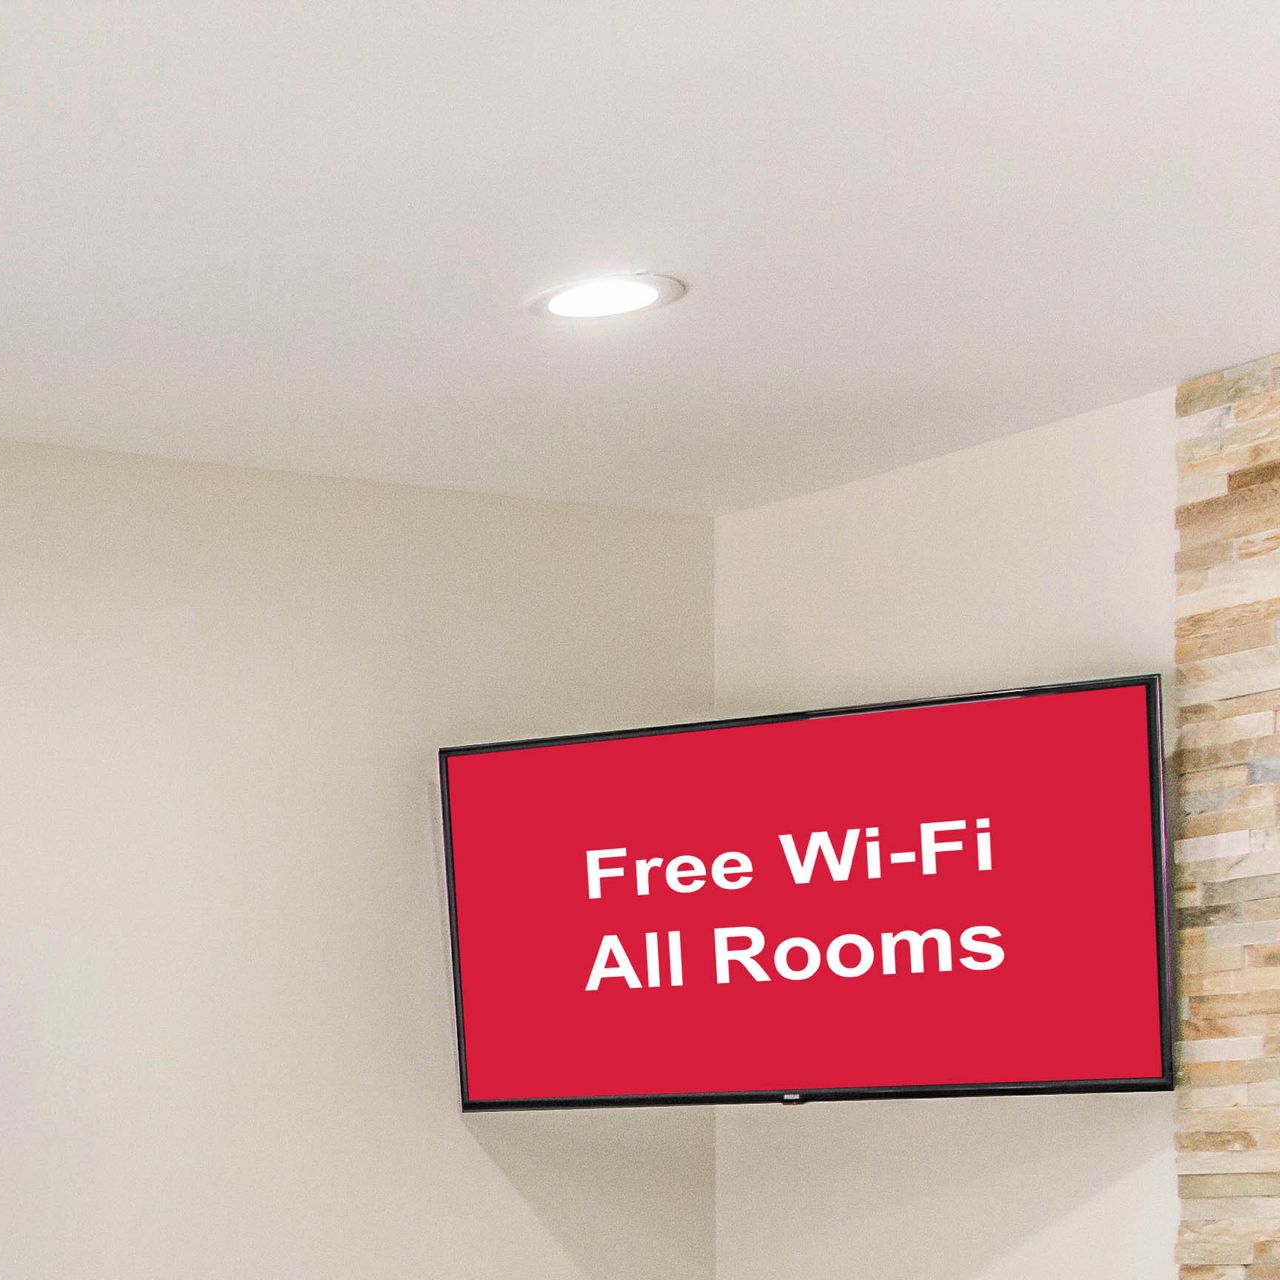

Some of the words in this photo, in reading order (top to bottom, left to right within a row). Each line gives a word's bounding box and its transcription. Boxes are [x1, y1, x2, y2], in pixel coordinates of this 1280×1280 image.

[585, 847, 753, 900] Free
[778, 817, 993, 885] Wi-Fi
[584, 930, 684, 992] All
[713, 925, 1005, 985] Rooms
